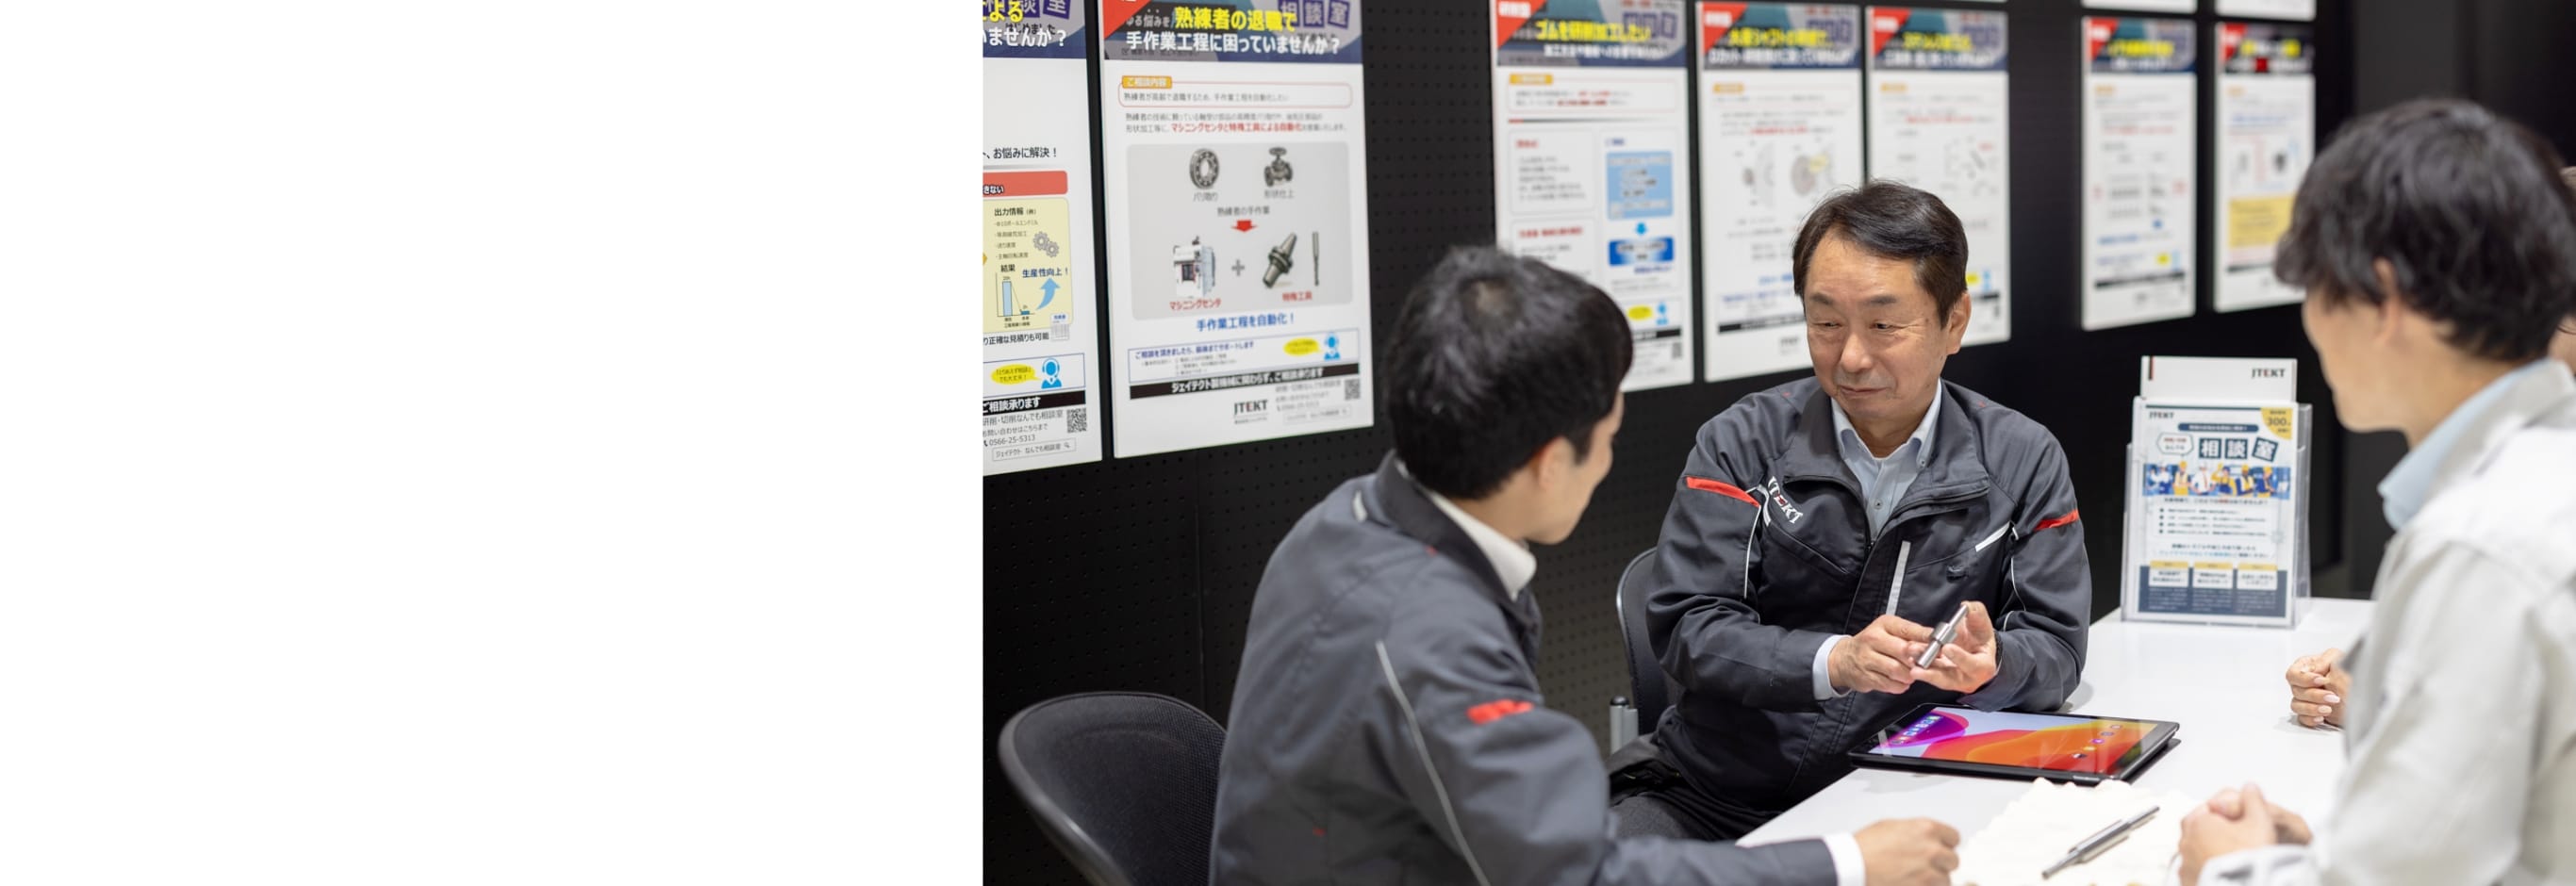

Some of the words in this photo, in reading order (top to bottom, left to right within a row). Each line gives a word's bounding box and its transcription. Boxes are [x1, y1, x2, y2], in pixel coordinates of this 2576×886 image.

[1174, 7, 1297, 32] 熟練者の退職で
[1126, 31, 1340, 55] 手作業工程に困っていませんか？
[1000, 264, 1016, 272] 結果
[1169, 298, 1222, 311] マシニングセンタ
[1197, 313, 1295, 332] 手作業工程を自動化！
[2252, 368, 2287, 379] JTEKT
[1234, 399, 1268, 415] JTEKT
[989, 434, 1035, 446] 0566-25-5313
